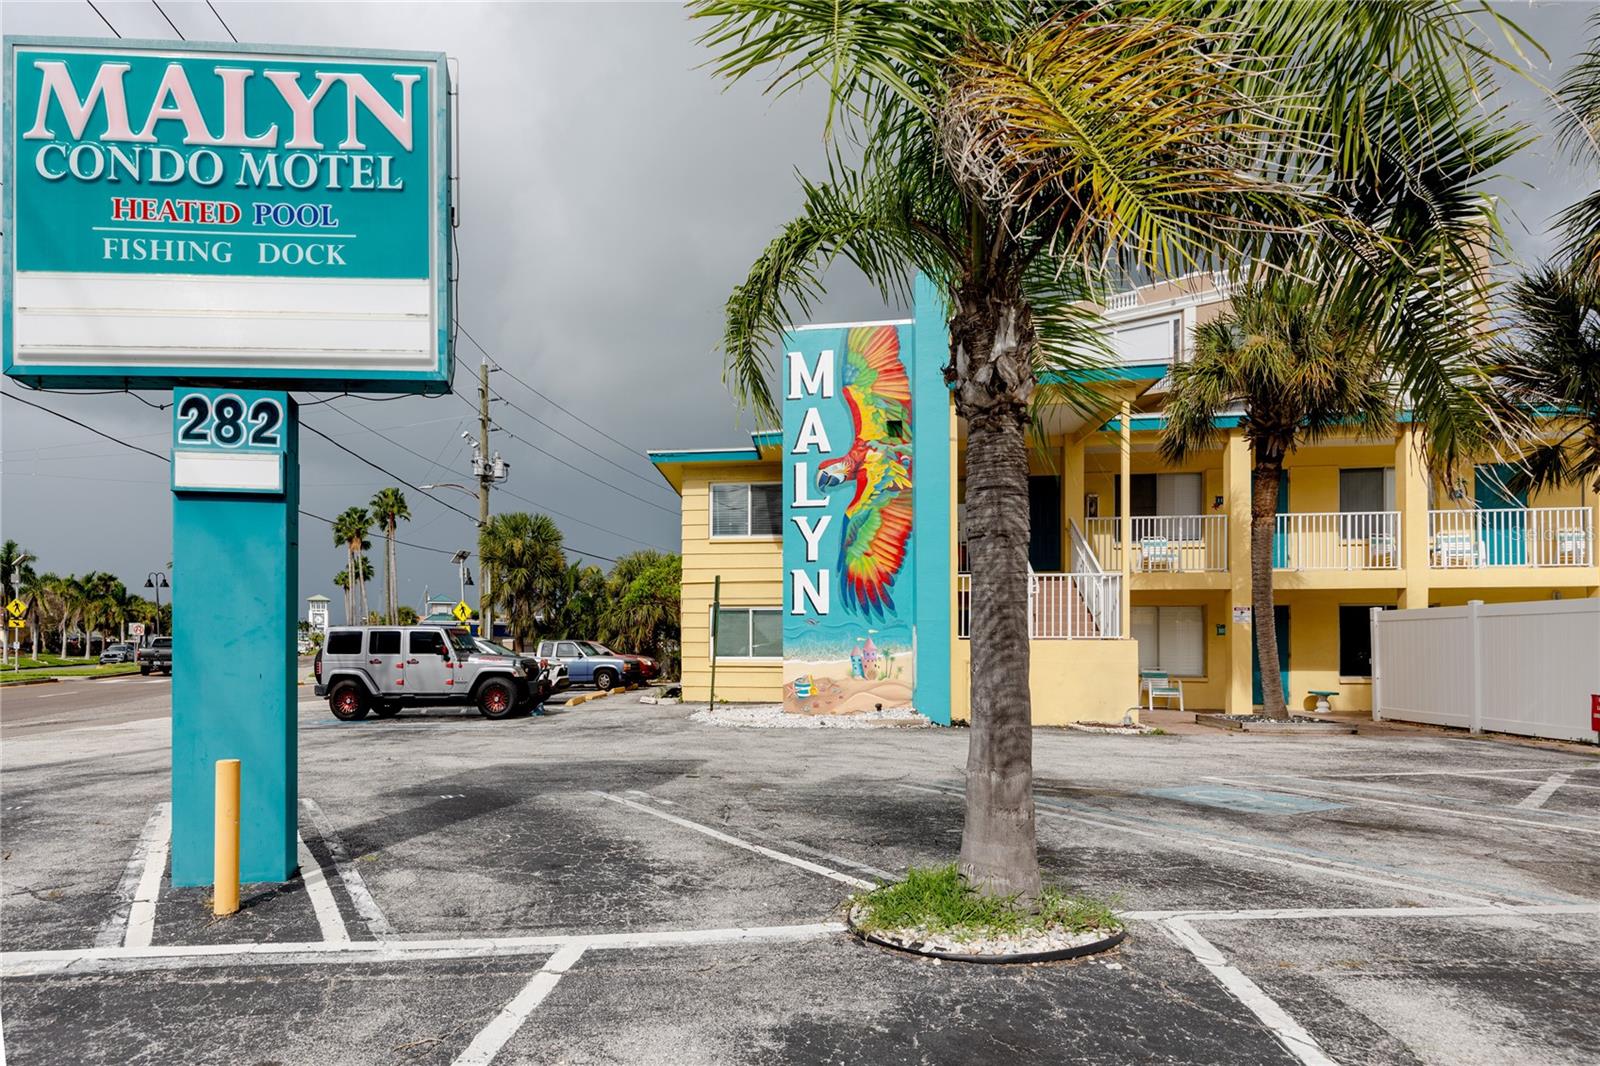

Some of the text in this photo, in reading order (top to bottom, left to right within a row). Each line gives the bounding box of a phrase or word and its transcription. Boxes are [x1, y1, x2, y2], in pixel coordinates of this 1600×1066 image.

[23, 60, 421, 152] MALYN
[35, 144, 403, 191] CONDO MOTEL
[111, 197, 339, 228] HEATED POOL
[102, 238, 347, 266] FISHING DOCK
[178, 393, 282, 448] 282
[786, 349, 835, 616] MALYN
